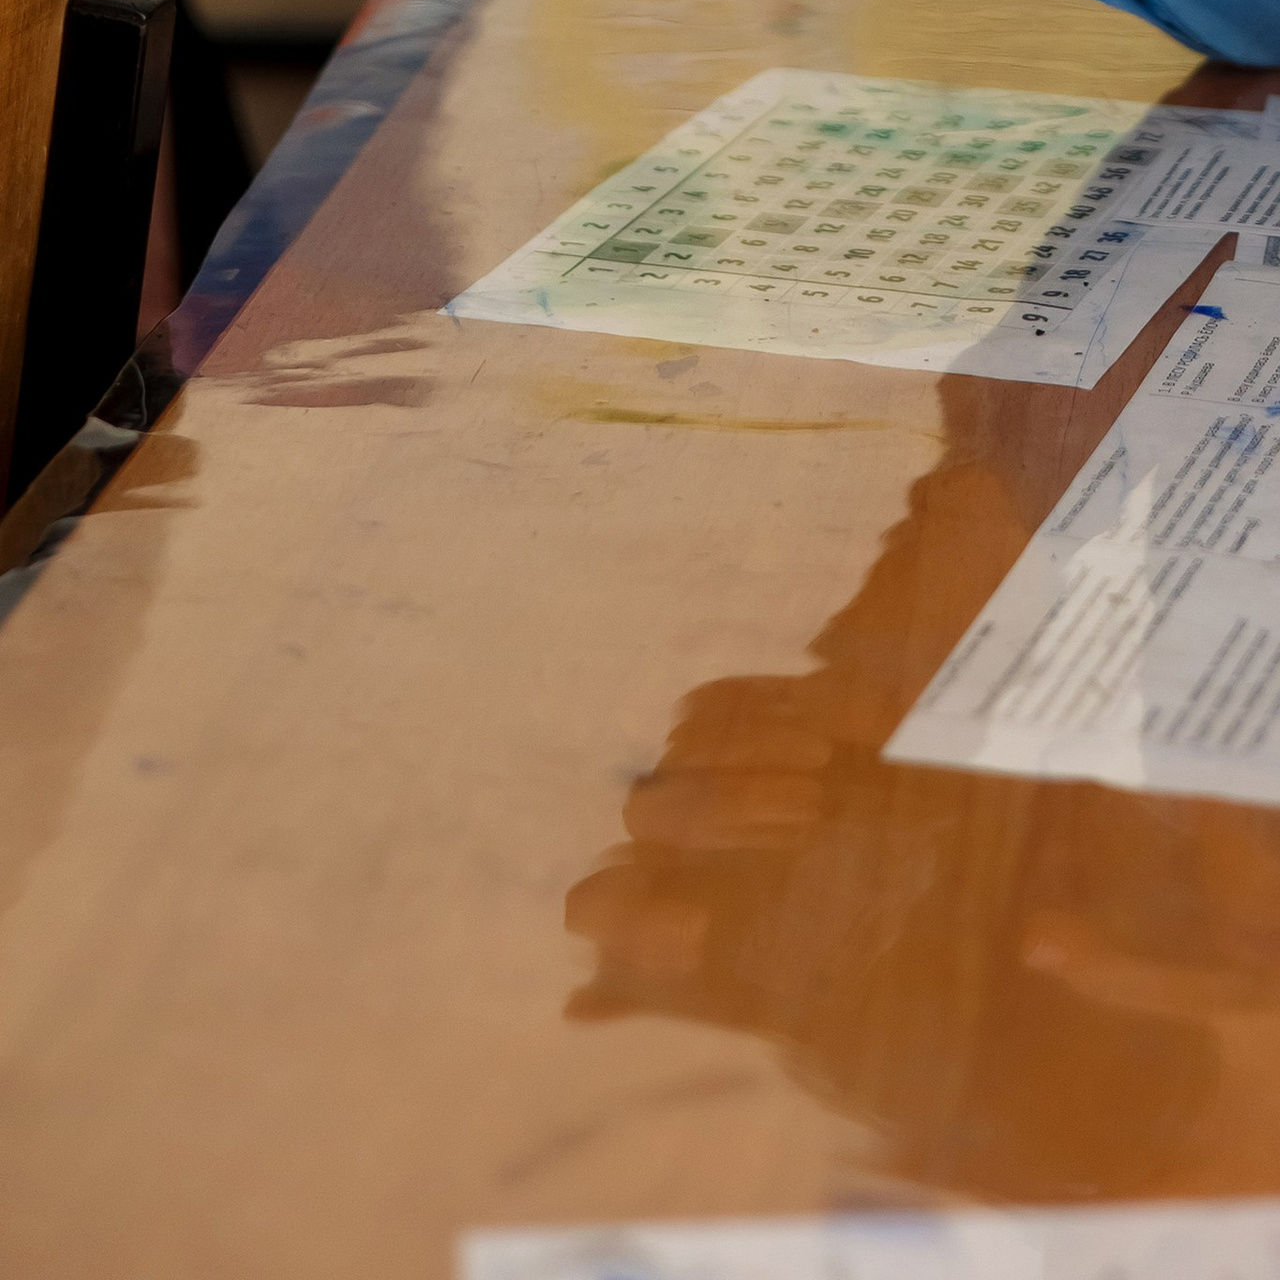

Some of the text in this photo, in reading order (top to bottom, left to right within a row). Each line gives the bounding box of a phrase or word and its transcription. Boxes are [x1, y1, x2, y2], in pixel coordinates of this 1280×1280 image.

[582, 222, 611, 230] 2
[634, 227, 663, 235] 2
[657, 208, 686, 216] 3
[638, 272, 669, 280] 2
[663, 252, 693, 261] 2
[711, 213, 738, 221] 6
[966, 167, 1132, 314] 8 8 24 32 48 56
[693, 278, 722, 287] 3
[716, 258, 746, 267] 3
[740, 239, 768, 247] 6
[748, 223, 846, 293] 4 4 8 12
[801, 209, 919, 298] 5 5 10 15 20
[857, 233, 951, 304] 6 6 12 18
[910, 219, 1023, 310] 7 7 14 21 28
[1021, 313, 1049, 323] 9
[1059, 269, 1092, 281] 18
[1078, 249, 1111, 262] 27
[1096, 231, 1130, 244] 36
[1166, 365, 1187, 382] ЛЕСУ
[1177, 335, 1210, 367] РОДИЛАСЬ
[1243, 357, 1270, 385] родилась
[1234, 383, 1253, 398] лесу
[1258, 384, 1277, 399] лесу
